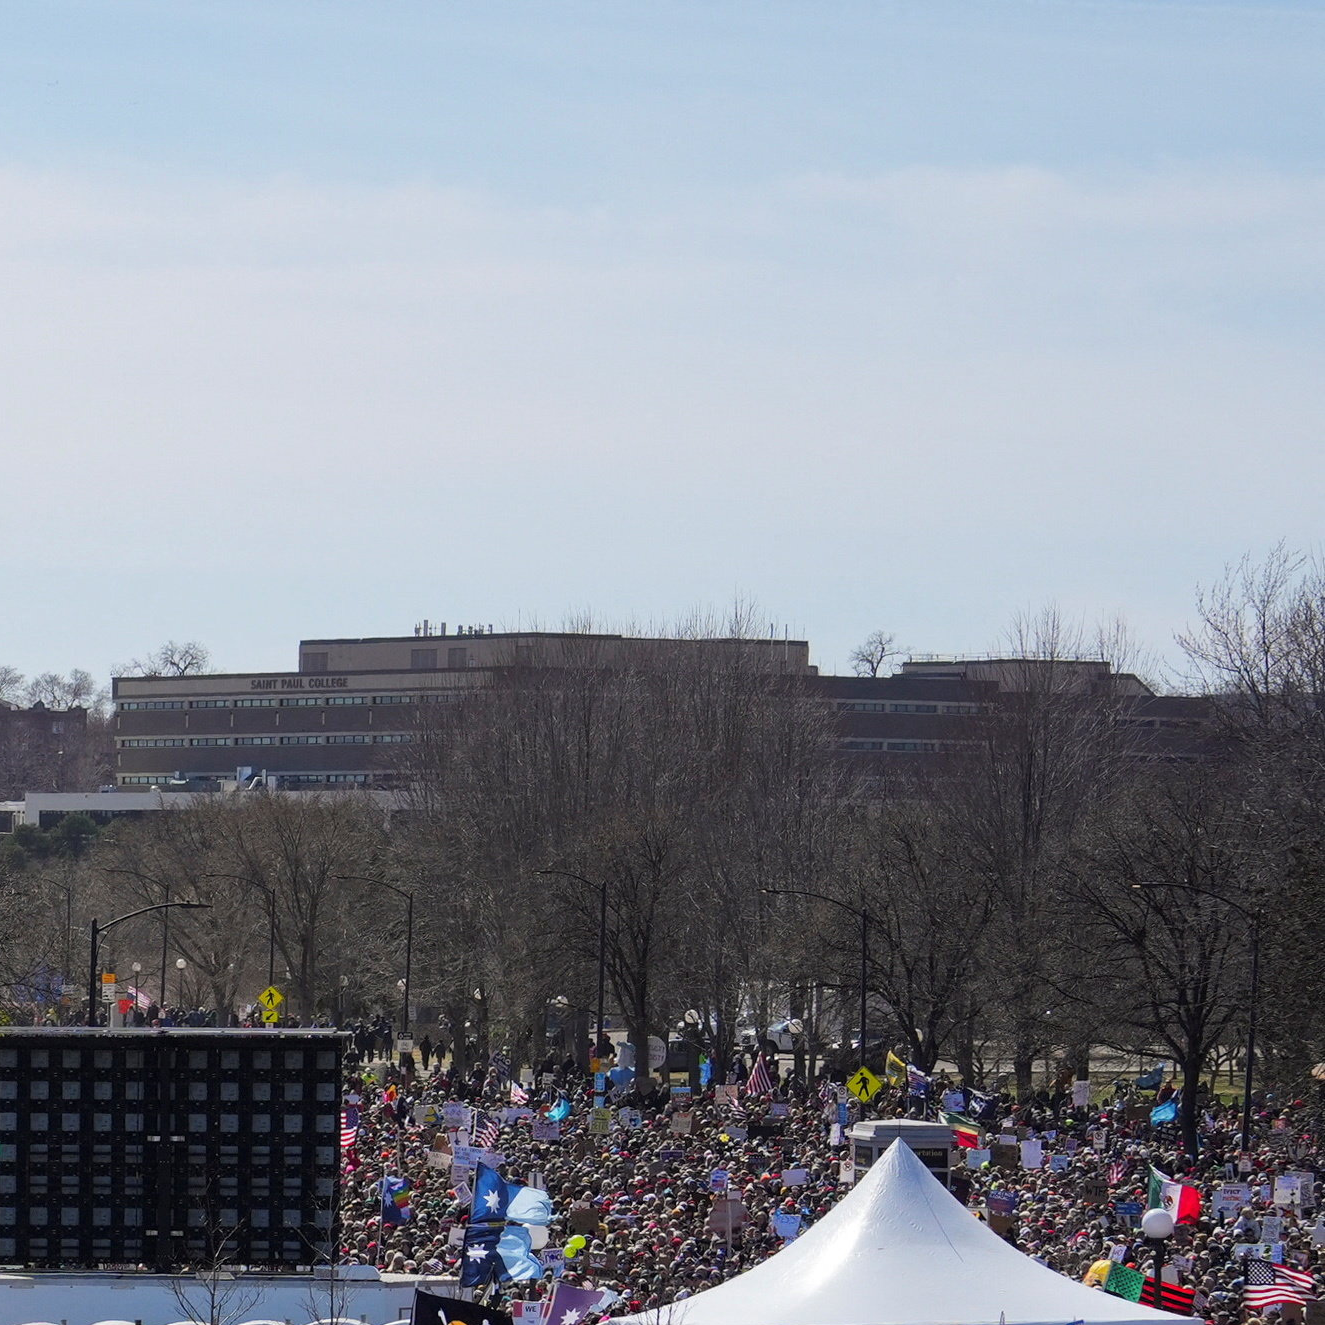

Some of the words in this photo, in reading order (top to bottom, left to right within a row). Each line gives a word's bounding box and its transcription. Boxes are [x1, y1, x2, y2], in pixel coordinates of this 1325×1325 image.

[251, 680, 277, 690] SAINT
[282, 679, 304, 688] PAUL
[309, 678, 348, 688] COLLEGE
